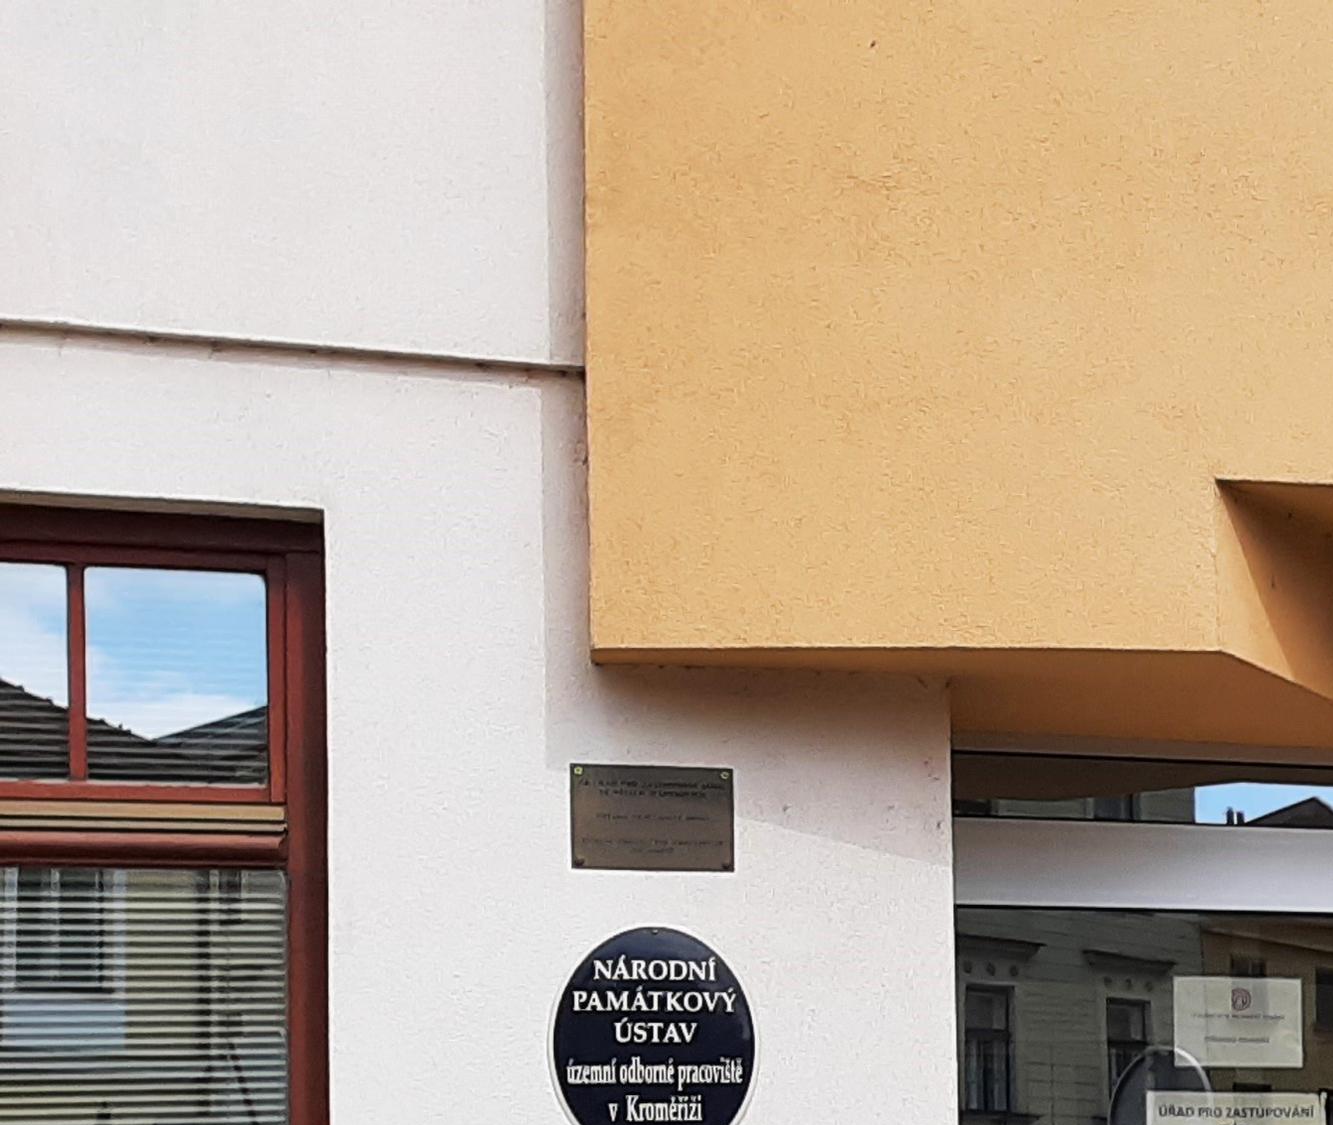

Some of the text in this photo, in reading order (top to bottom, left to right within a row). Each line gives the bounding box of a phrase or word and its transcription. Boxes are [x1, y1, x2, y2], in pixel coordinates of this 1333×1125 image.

[593, 954, 717, 981] NÁRODNÍ
[572, 985, 737, 1012] PAMÁTKOVÝ
[613, 1017, 698, 1043] ÚSTAV
[566, 1056, 743, 1092] územní odborné pracoviště
[608, 1094, 703, 1121] v Kroměříži
[1198, 1105, 1223, 1118] PRO
